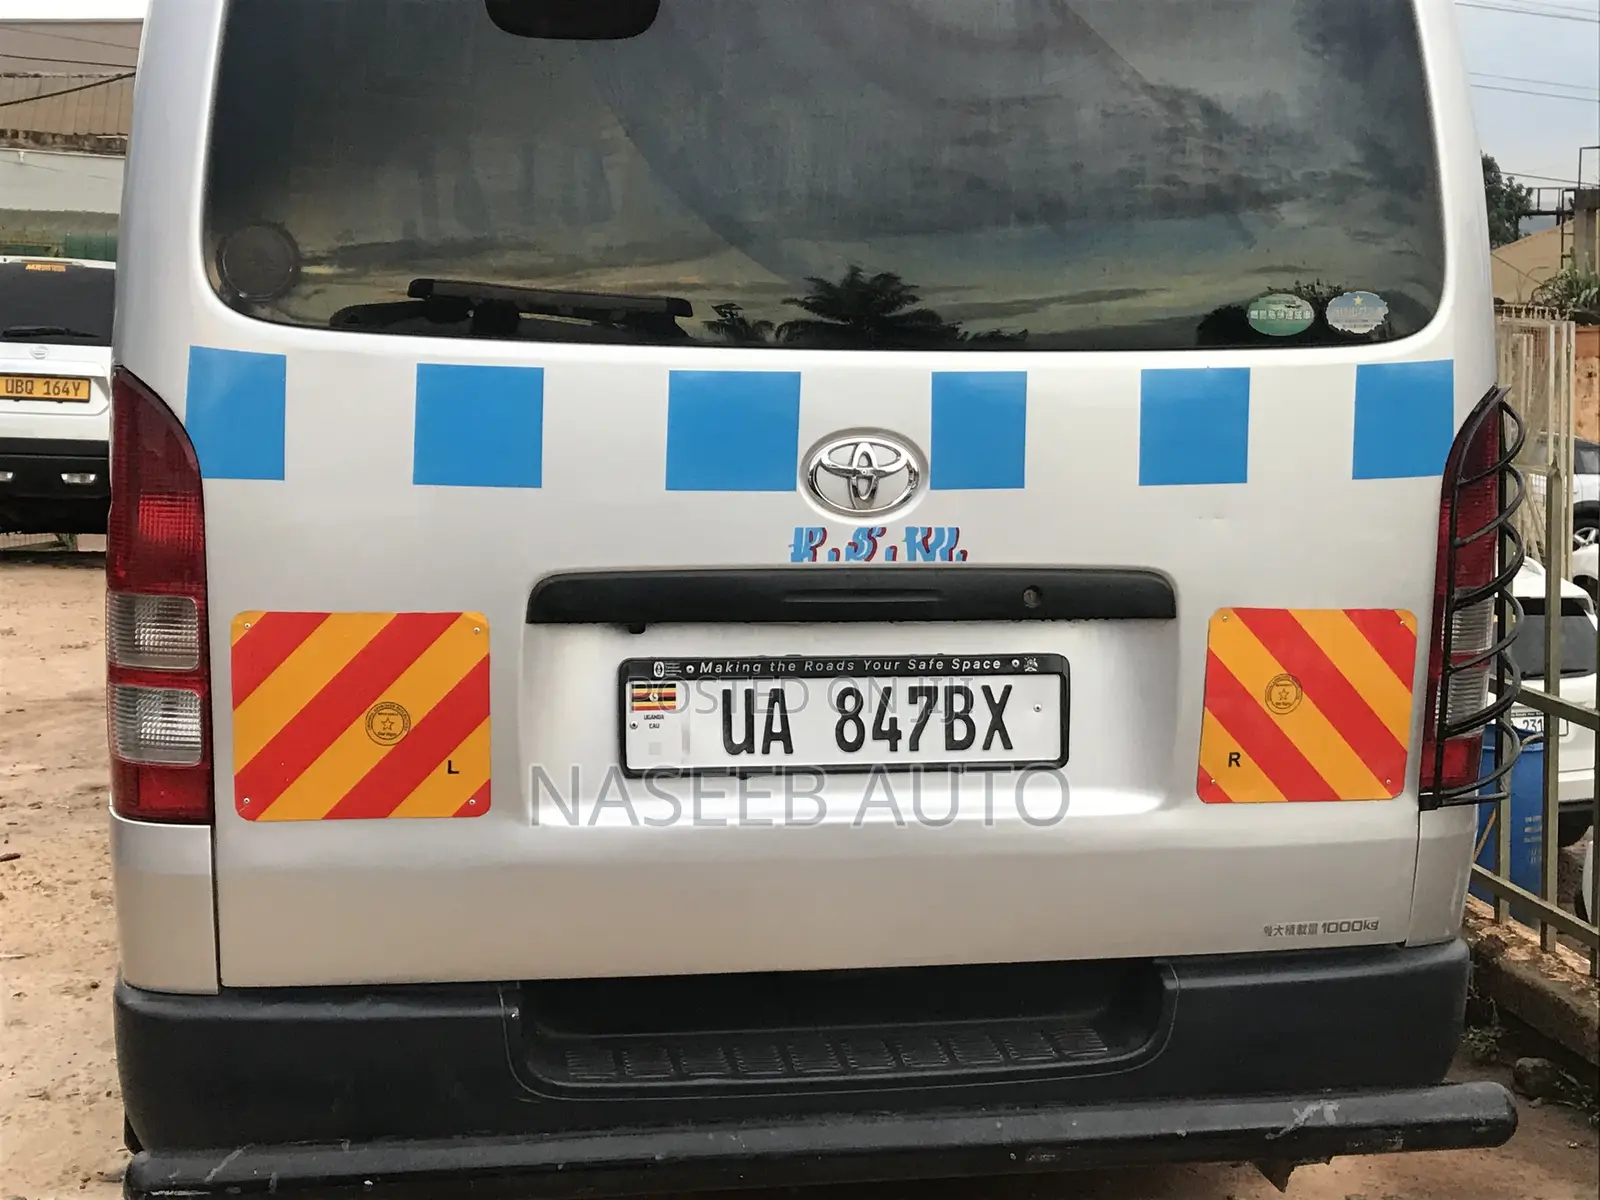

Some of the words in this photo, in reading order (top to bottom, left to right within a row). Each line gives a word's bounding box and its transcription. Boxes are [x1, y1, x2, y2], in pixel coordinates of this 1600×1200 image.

[5, 379, 34, 395] UBQ
[43, 380, 81, 397] 164Y
[700, 661, 762, 675] Making
[770, 661, 796, 672] the
[804, 660, 855, 671] Roads
[863, 659, 901, 671] Your
[908, 658, 944, 670] Safe
[951, 658, 1001, 672] Space
[722, 686, 794, 756] UA
[835, 684, 1014, 753] 847BX
[447, 760, 459, 774] L
[1228, 752, 1241, 768] R
[1321, 919, 1380, 934] 1000kg
